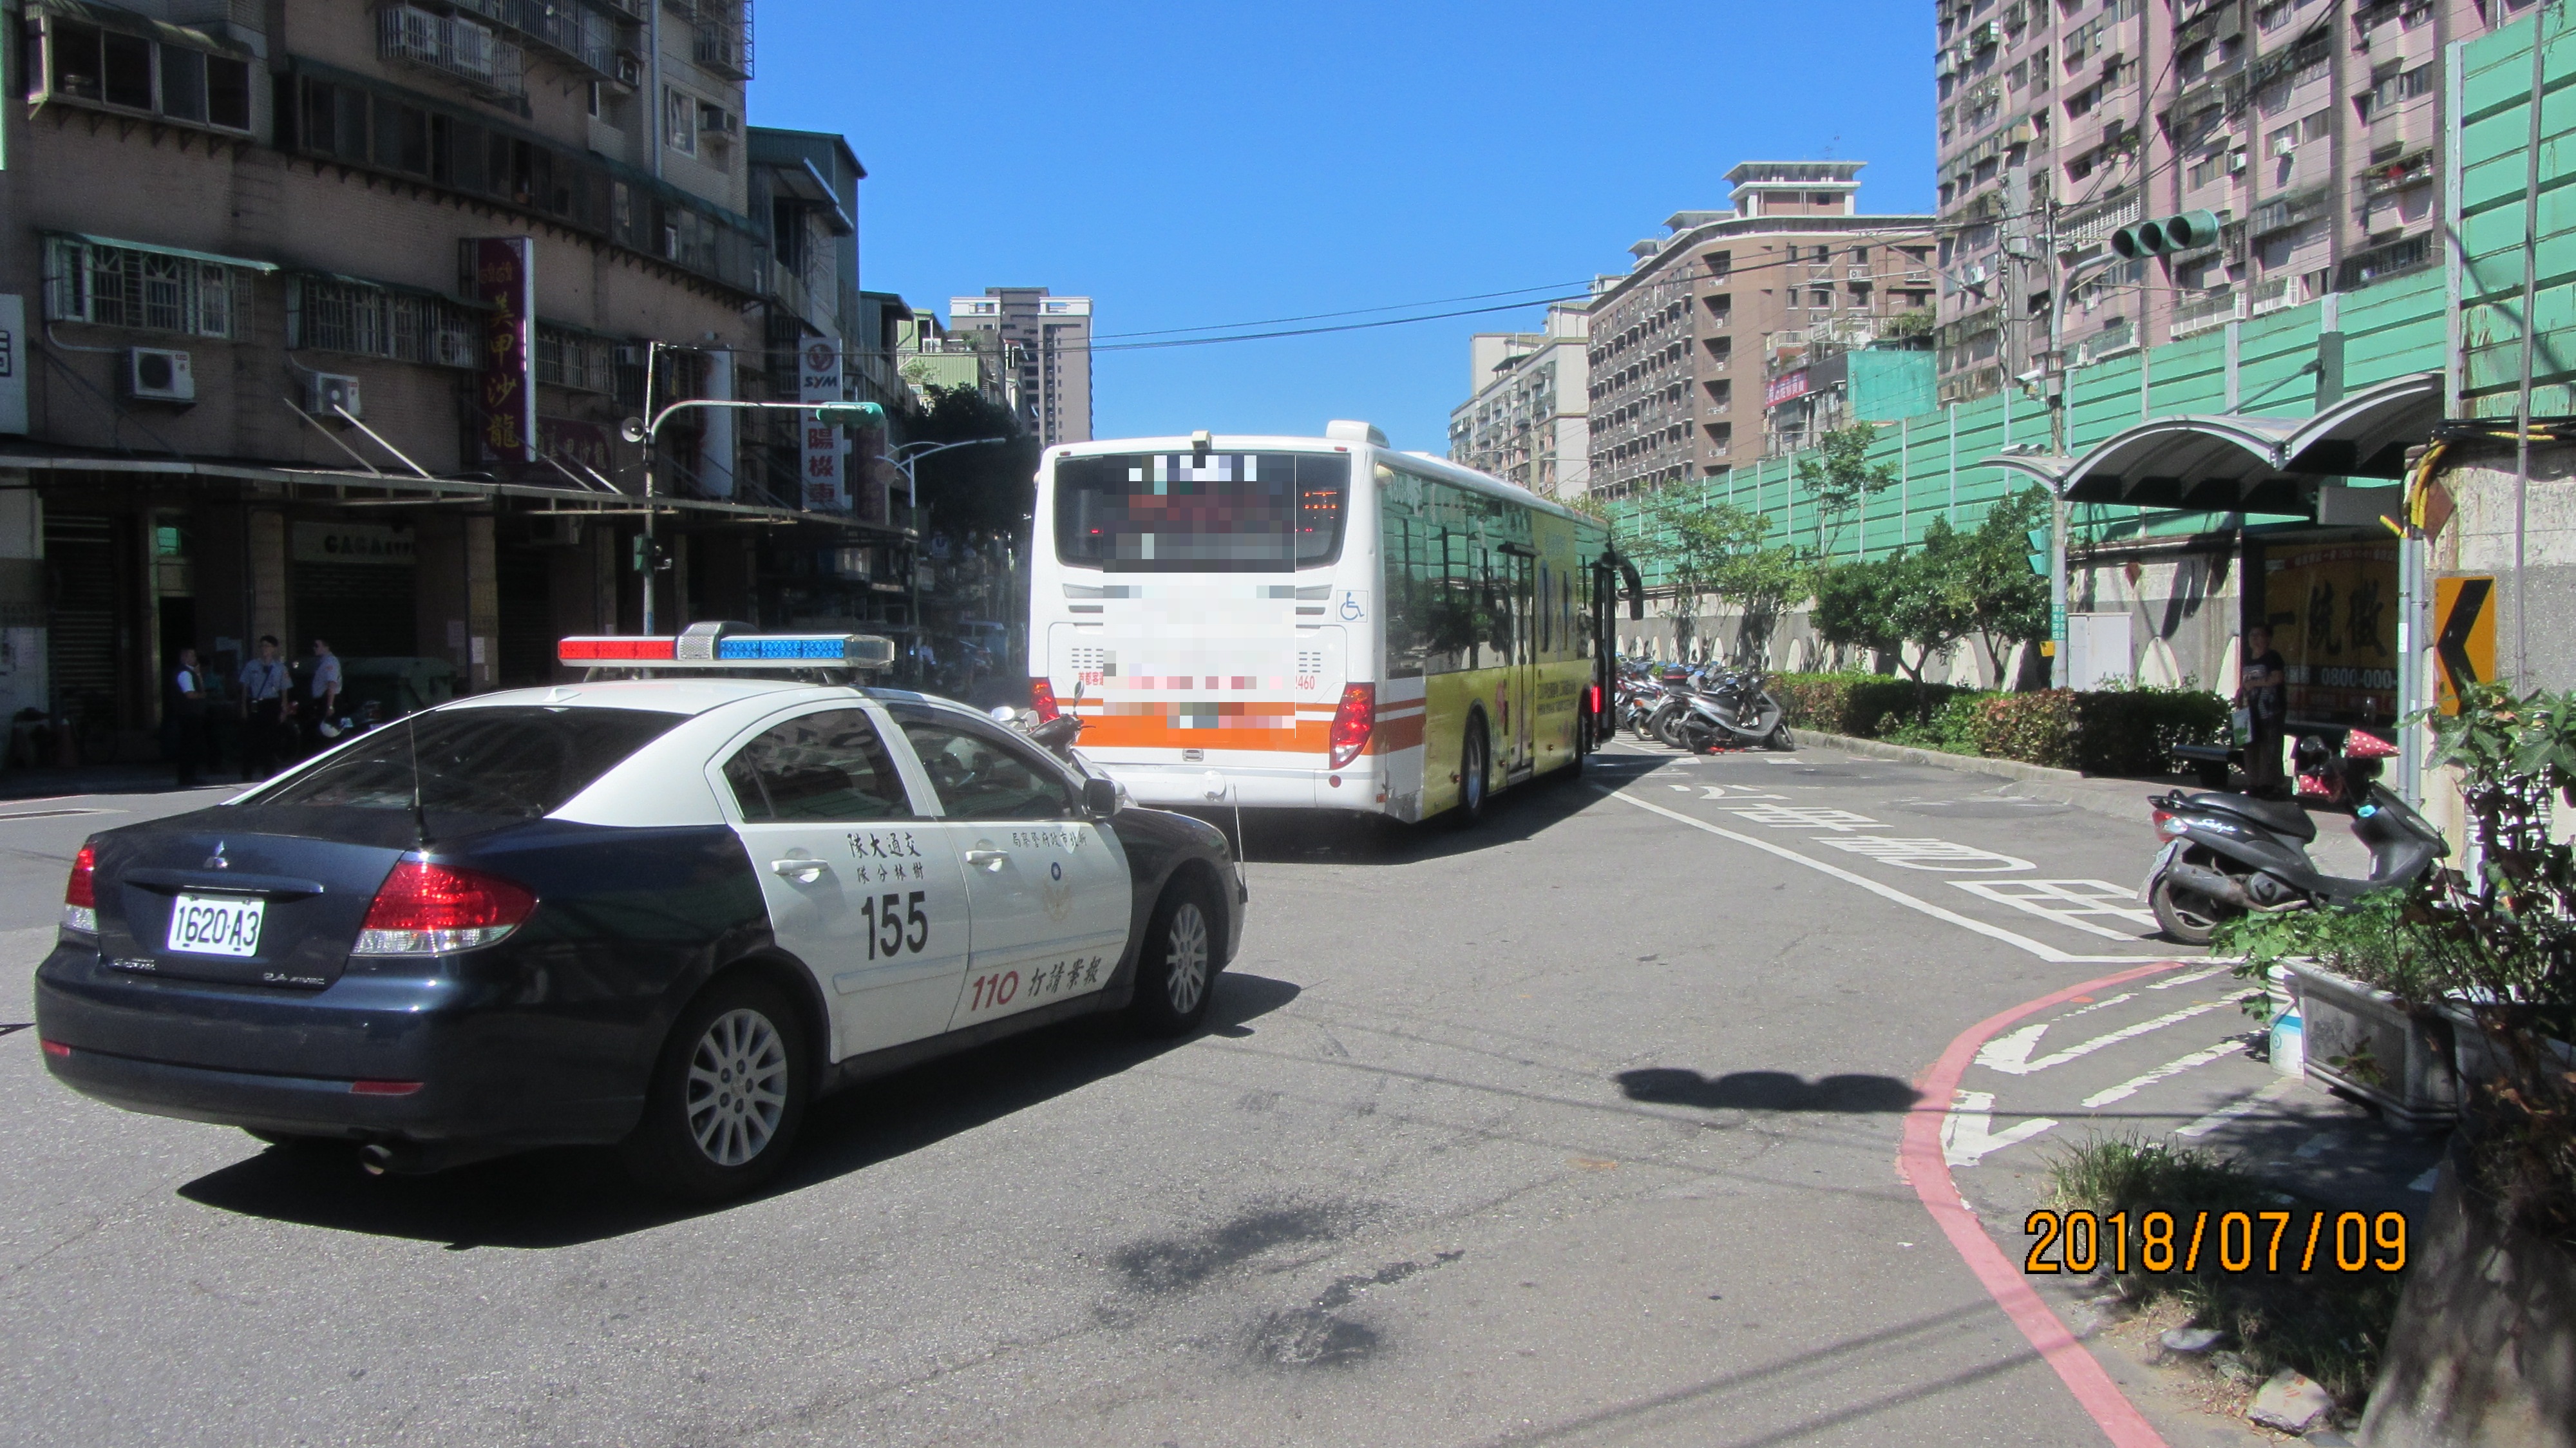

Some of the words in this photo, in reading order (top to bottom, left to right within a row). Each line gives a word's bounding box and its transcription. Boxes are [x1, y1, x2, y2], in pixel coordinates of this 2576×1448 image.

[487, 291, 520, 449] 美甲沙龍
[804, 376, 837, 388] SYM
[860, 890, 929, 960] 155
[971, 970, 1019, 1012] 110
